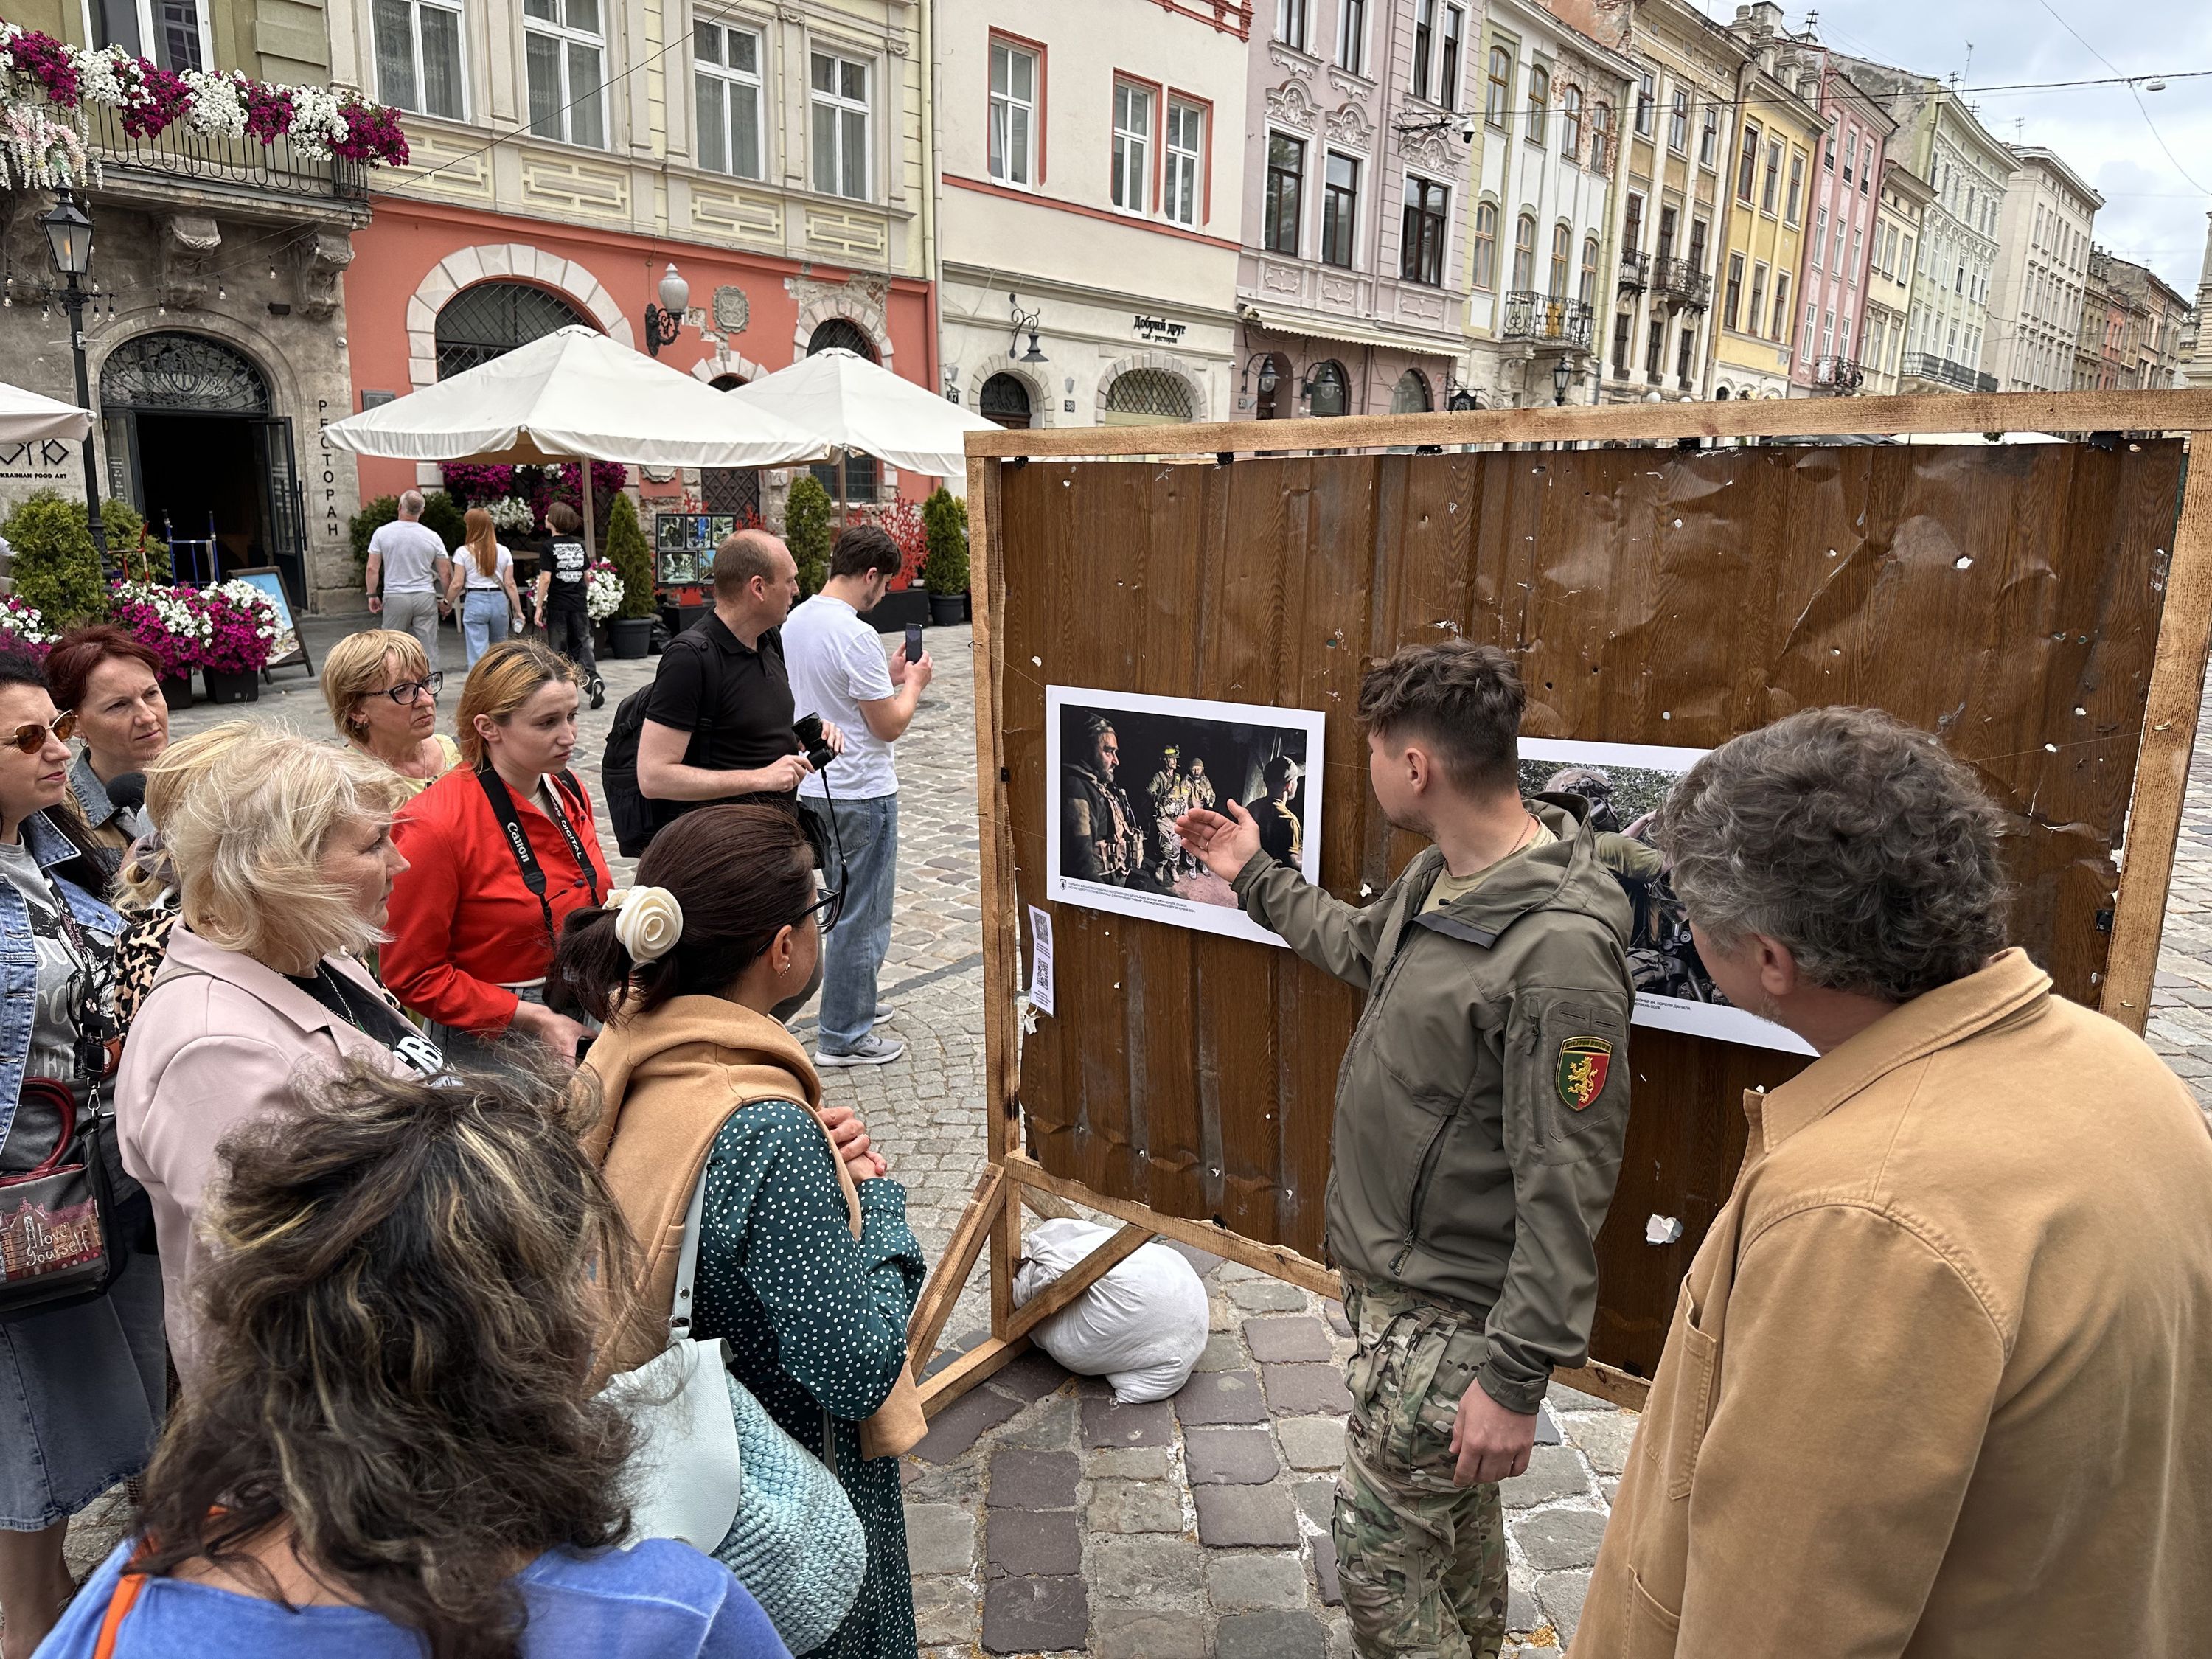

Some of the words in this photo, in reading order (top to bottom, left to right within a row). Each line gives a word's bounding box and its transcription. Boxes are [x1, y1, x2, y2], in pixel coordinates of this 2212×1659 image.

[1133, 316, 1166, 334] Добрий
[1167, 323, 1186, 337] друг
[507, 822, 530, 863] Canon
[561, 820, 582, 860] DIGITAL
[27, 1229, 89, 1266] yourself
[38, 1223, 68, 1247] love
